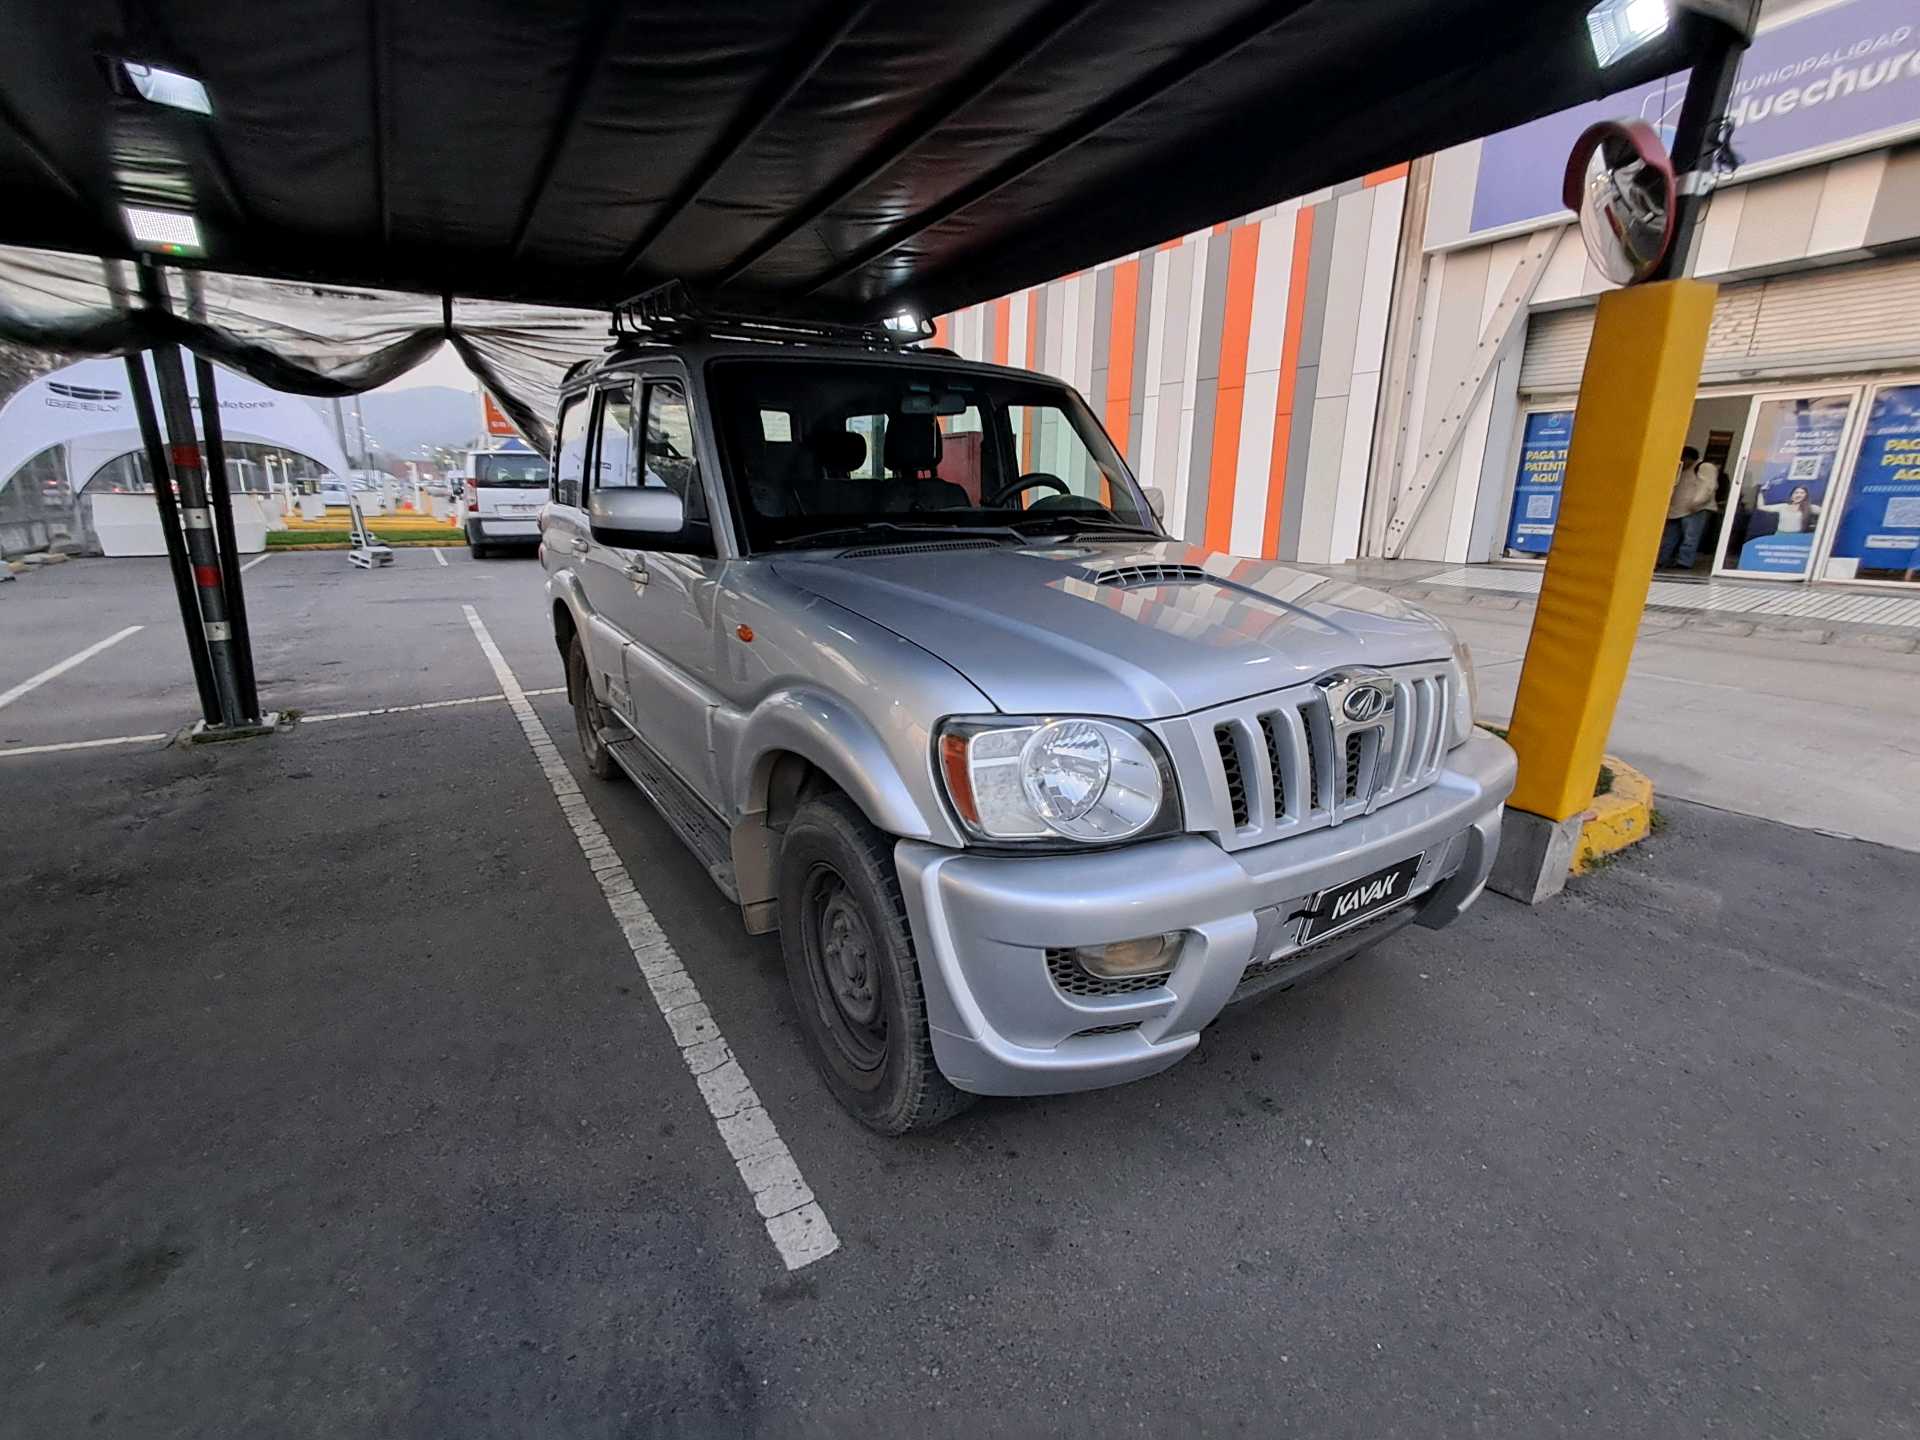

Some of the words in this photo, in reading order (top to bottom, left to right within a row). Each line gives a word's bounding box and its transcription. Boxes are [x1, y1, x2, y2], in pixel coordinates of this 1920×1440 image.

[46, 398, 121, 412] GEELY
[1884, 439, 1920, 451] PAG
[1526, 450, 1556, 460] PAGA
[1331, 871, 1400, 920] KAVAK
